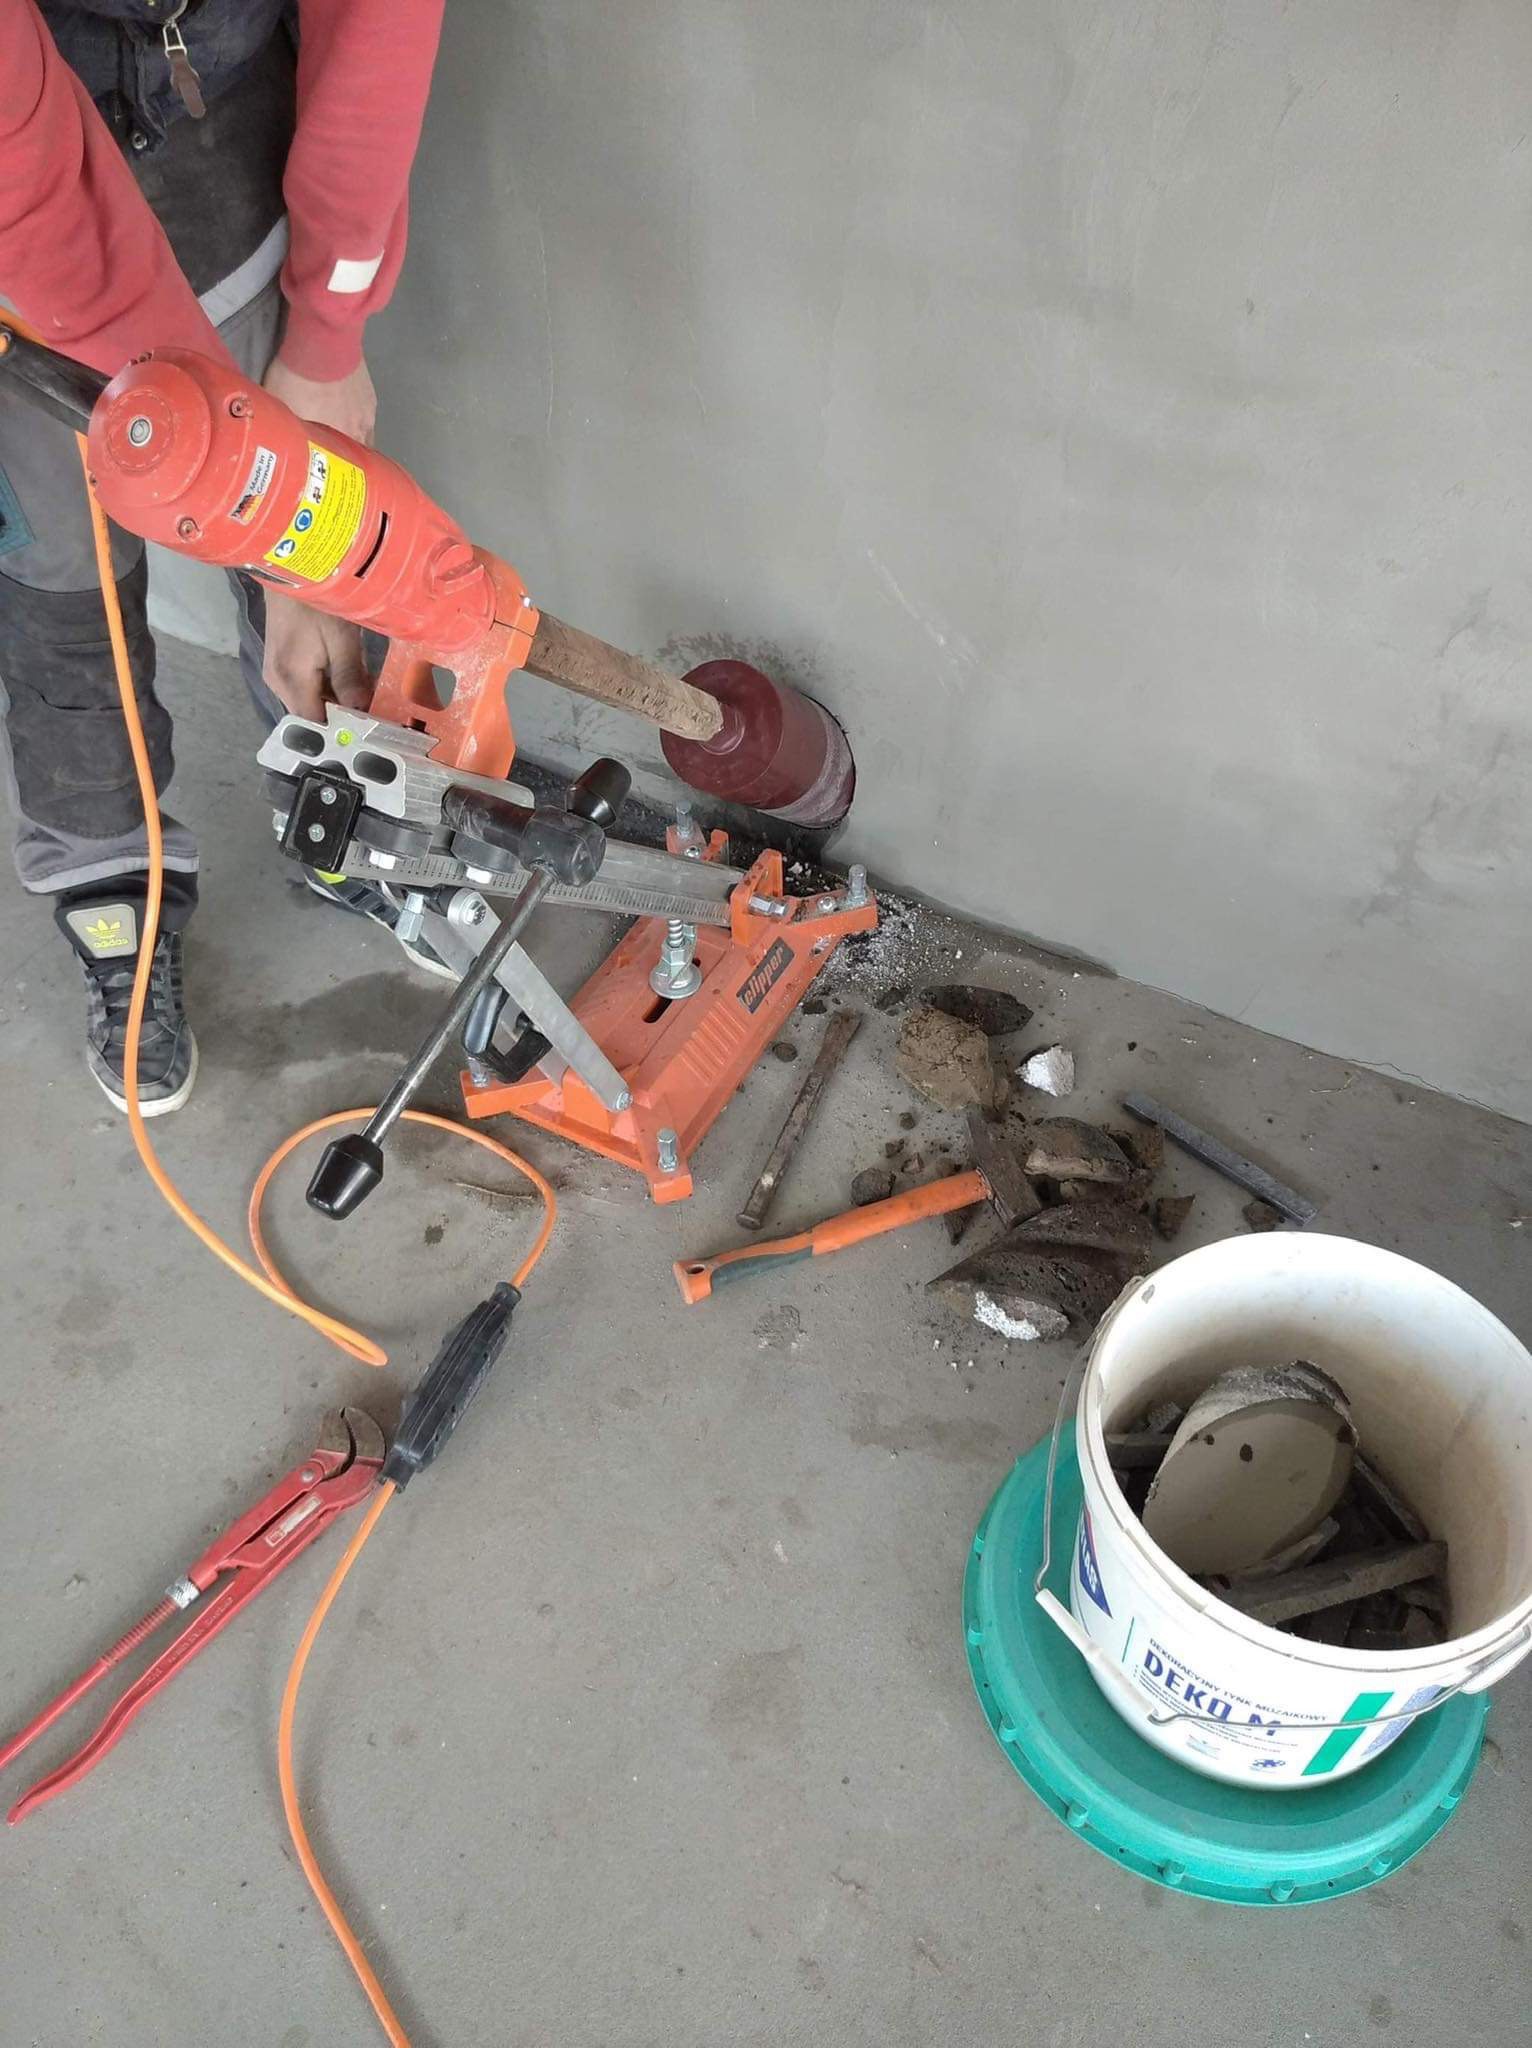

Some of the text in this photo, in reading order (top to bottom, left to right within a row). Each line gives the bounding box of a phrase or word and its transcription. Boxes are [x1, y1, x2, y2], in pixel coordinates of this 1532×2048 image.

[249, 465, 262, 490] Made
[257, 453, 275, 494] Germany
[744, 946, 784, 1006] clipper
[1144, 1648, 1233, 1724] DEKO
[1149, 1637, 1328, 1721] DEKORACYJNY TYNK MOZAIKOWY
